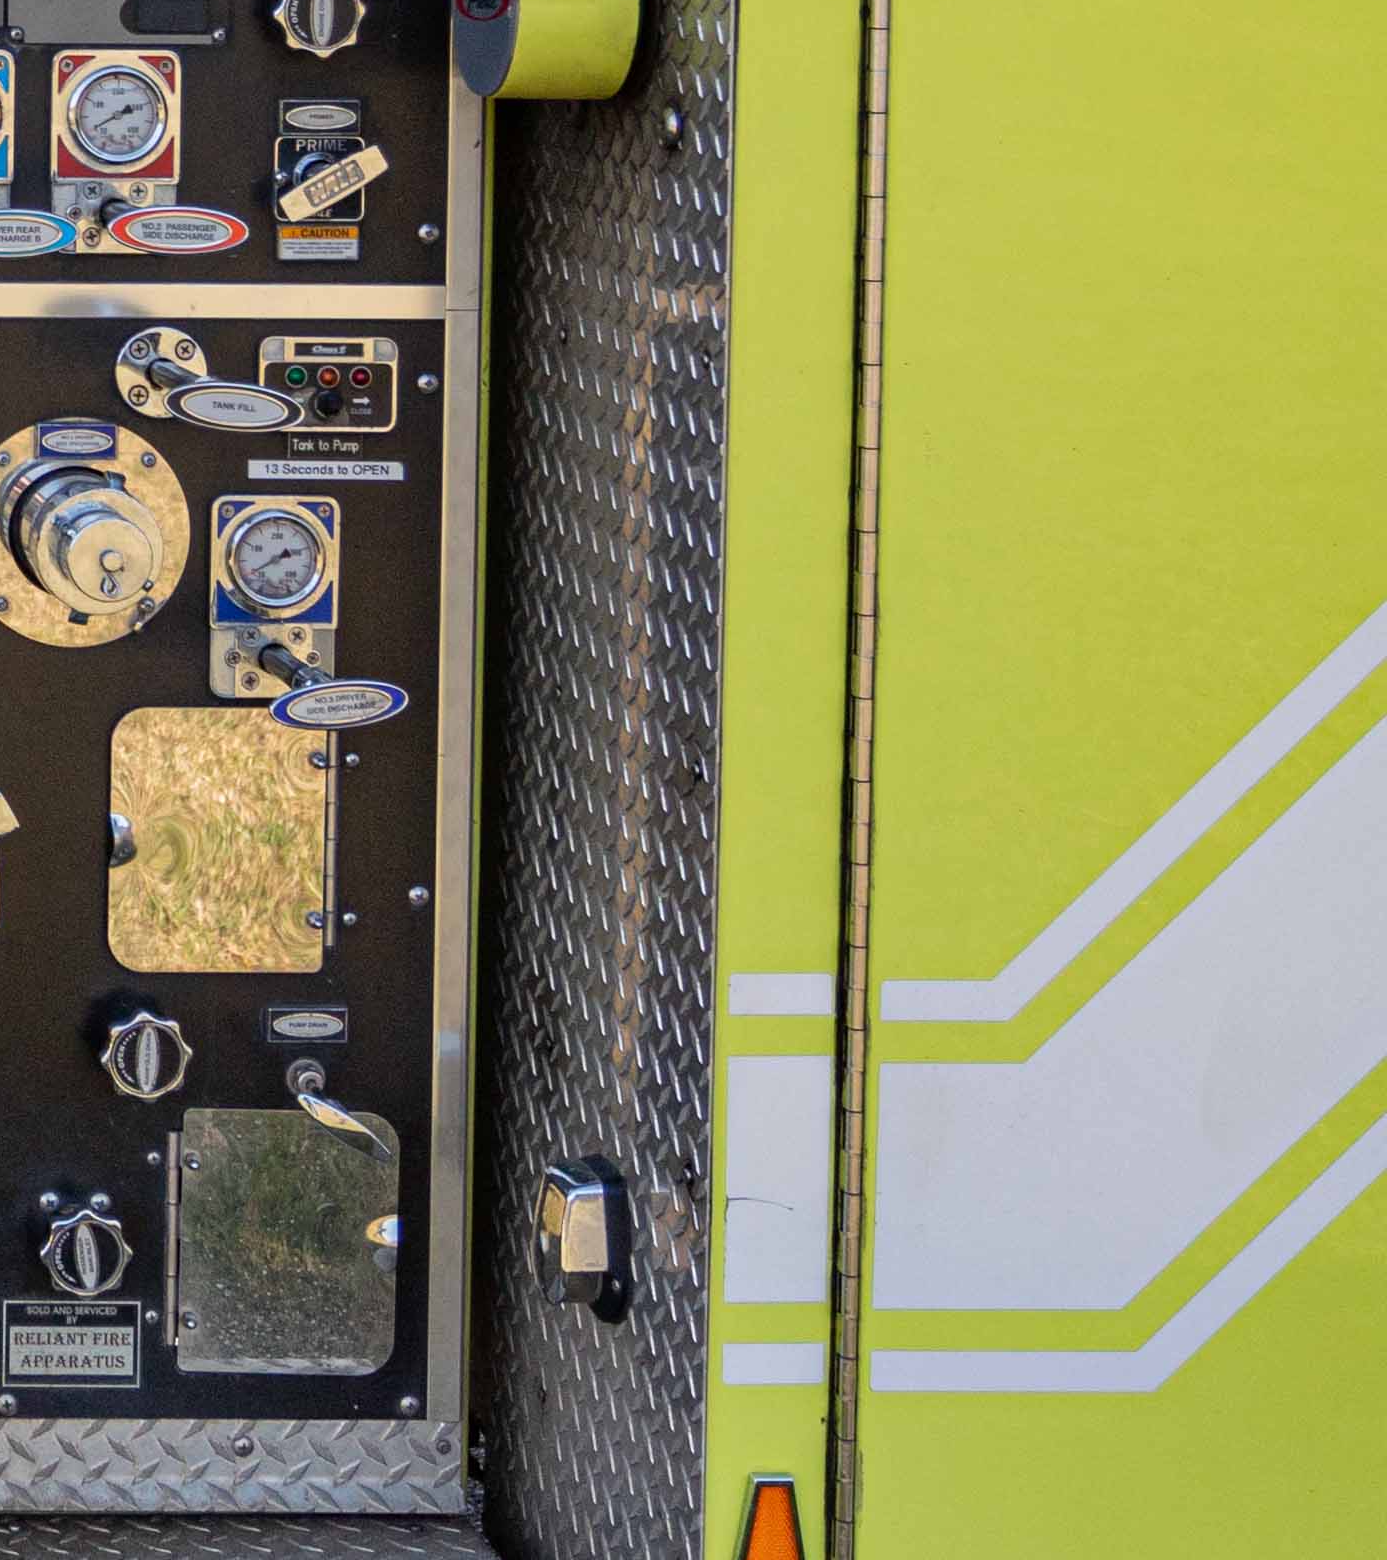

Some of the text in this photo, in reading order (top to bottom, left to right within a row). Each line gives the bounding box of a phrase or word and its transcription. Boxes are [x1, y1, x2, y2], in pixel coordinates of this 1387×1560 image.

[295, 139, 347, 152] PRIME
[15, 226, 41, 234] REAR
[142, 230, 215, 242] SIDE DISCHARGE
[300, 228, 350, 239] CAUTION
[212, 401, 256, 413] TANK FILL
[292, 439, 359, 454] Tank to Pump
[264, 464, 390, 476] 13 Seconds to OPEN
[27, 1307, 117, 1315] SOLD AND SERVICED
[66, 1316, 78, 1324] BY
[14, 1333, 132, 1346] RELIANT FIRE
[20, 1355, 126, 1368] APPARATUS
